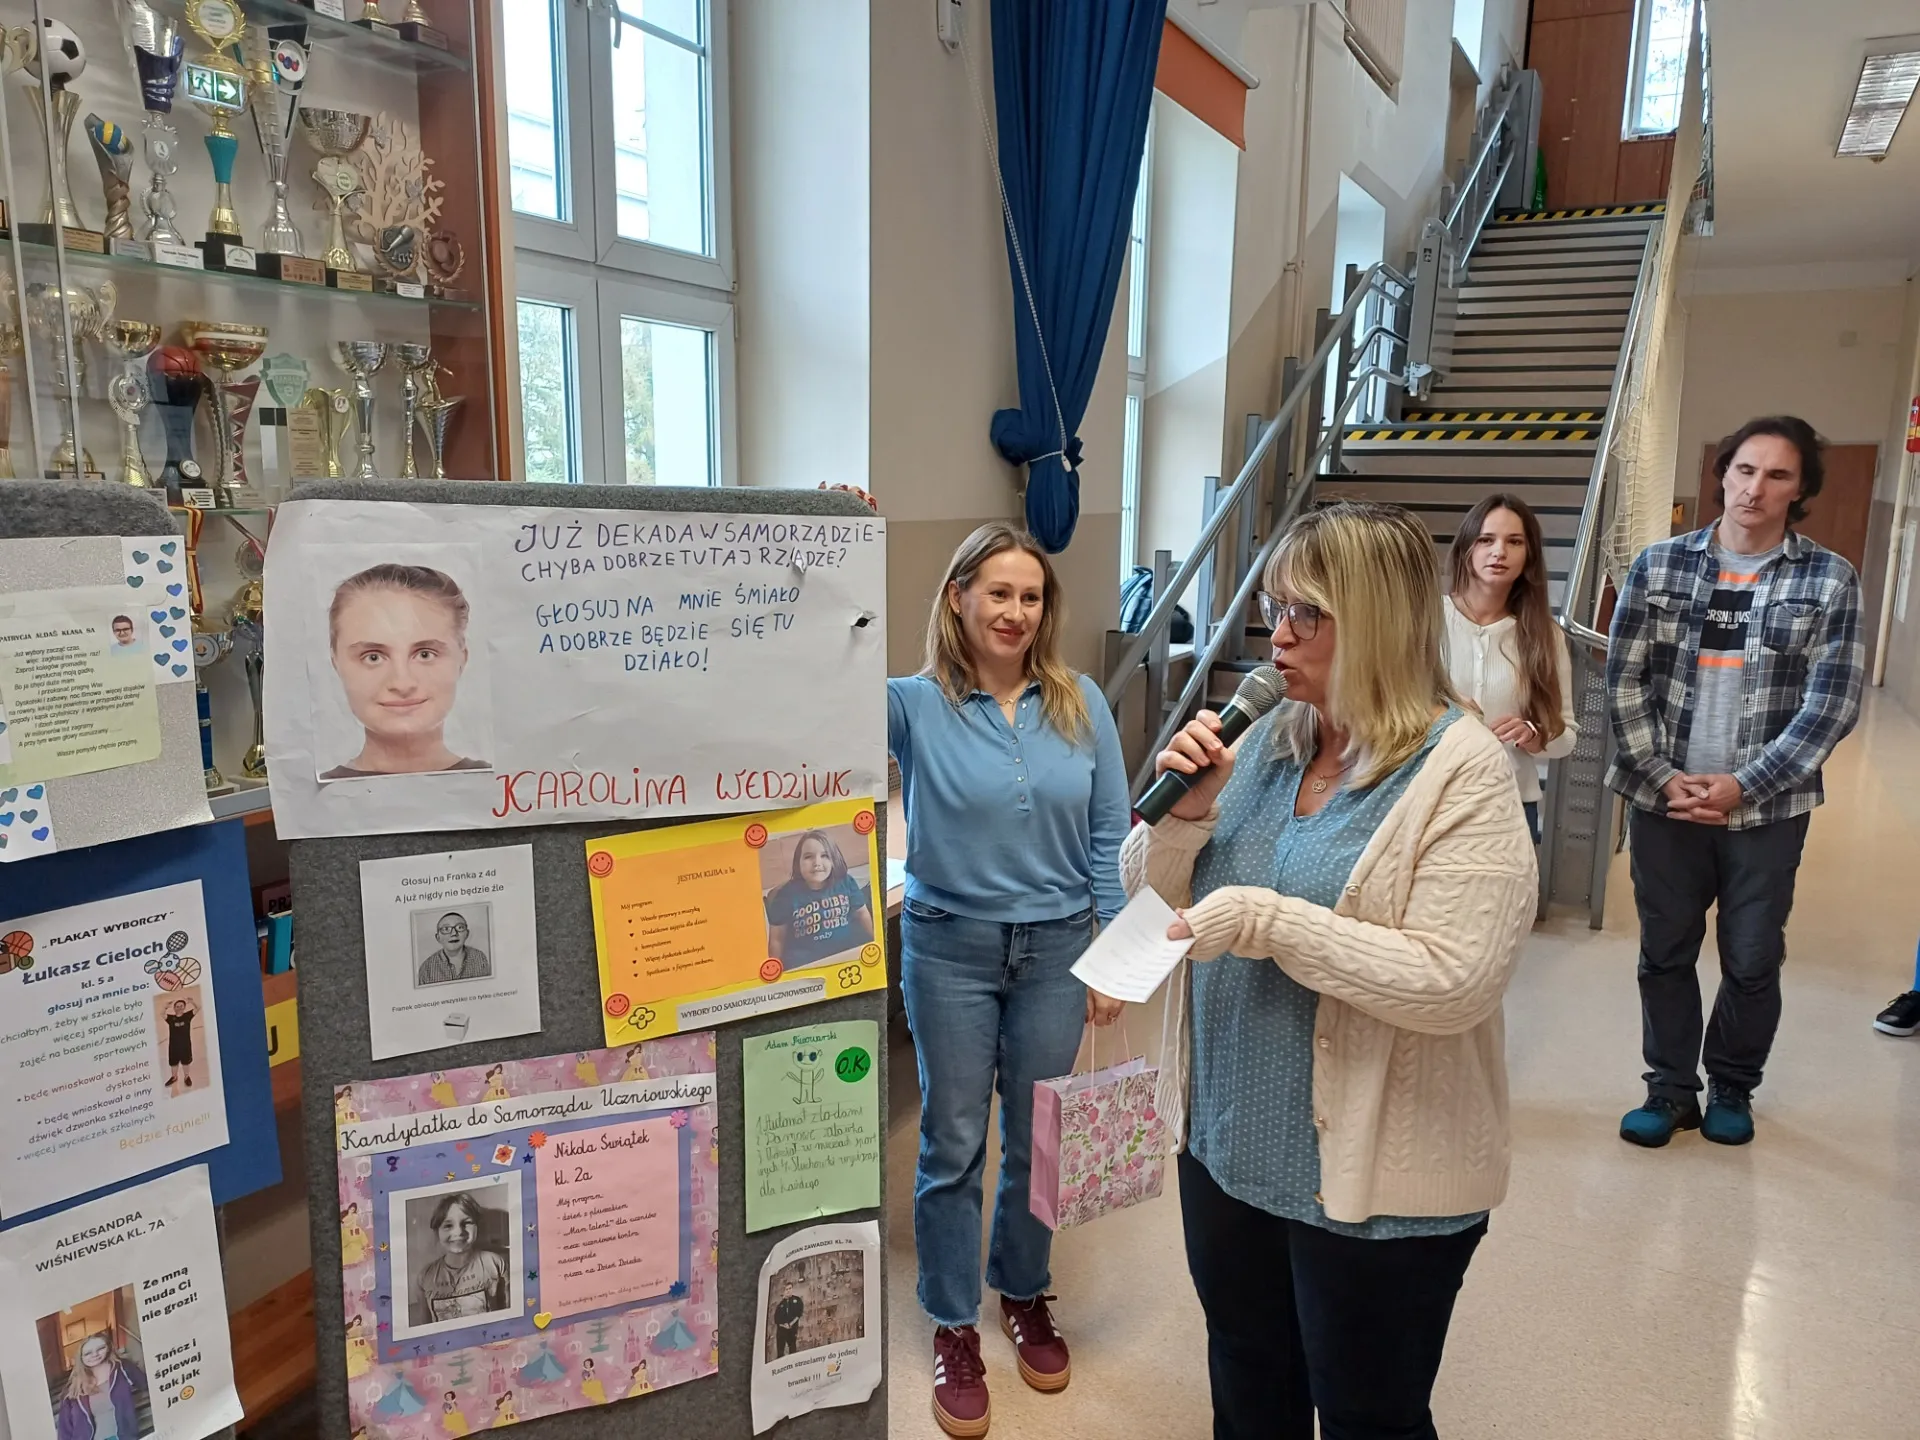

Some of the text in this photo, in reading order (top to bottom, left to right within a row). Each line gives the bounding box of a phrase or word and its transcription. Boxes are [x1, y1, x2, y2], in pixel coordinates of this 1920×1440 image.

[514, 520, 583, 553] JUŻ
[521, 558, 596, 582] CHYBA
[603, 551, 675, 571] DOBRZE
[680, 548, 751, 566] TUTAJ
[536, 582, 800, 627] GŁOSUJ NA MNIE ŚMIAŁO
[539, 613, 794, 653] A DOBRZE BĘDZIE SIĘ TU
[625, 648, 708, 671] DZIAŁO!
[492, 767, 688, 818] KAROLINA
[401, 876, 431, 887] Głosuj
[446, 871, 477, 881] Franka
[485, 869, 497, 877] 4d
[677, 872, 703, 885] JESTEM
[704, 868, 723, 878] KUBA
[395, 884, 504, 904] A już nigdy nie będzie źle
[793, 901, 820, 919] GOOD
[813, 931, 832, 941] only
[21, 941, 164, 985] Łukasz Cieloch
[81, 978, 95, 990] kl.
[98, 977, 104, 985] 5
[47, 983, 150, 1015] głosuj na mnie bo:
[392, 1004, 412, 1012] Franek
[413, 1001, 440, 1010] obiecuje
[681, 984, 823, 1019] WYBORY DO SAMORZĄDU UCZNIOWSKIEGO
[0, 1025, 52, 1044] chciałbym,
[55, 1017, 79, 1029] żeby
[91, 1005, 121, 1019] szkole
[124, 1000, 143, 1012] było
[53, 1031, 85, 1044] więcej
[764, 1040, 788, 1051] Adam
[20, 1053, 47, 1069] zajęć
[49, 1051, 61, 1059] na
[93, 1040, 148, 1062] sportowych
[836, 1055, 869, 1075] O.K.
[24, 1089, 49, 1102] będę
[51, 1073, 105, 1093] wnioskował
[114, 1060, 150, 1075] szkolne
[105, 1074, 151, 1093] dyskoteki
[44, 1087, 153, 1125] będę wnioskował o inny
[341, 1081, 713, 1153] Kandydatka do Samorządu Uczniowskiego
[28, 1100, 154, 1145] dźwięk dzwonka szkolnego
[23, 1113, 156, 1161] więcej wycieczek szkolnych
[119, 1131, 163, 1150] Będzie
[554, 1129, 650, 1159] Nikola Świątek
[554, 1167, 593, 1186] kl. 2a
[55, 1211, 143, 1250] ALEKSANDRA
[615, 1217, 628, 1225] dla
[36, 1219, 165, 1274] WIŚNIEWSKA KL. 7A
[804, 1240, 833, 1251] ZAWADZKI
[142, 1266, 189, 1291] Ze mną
[144, 1279, 192, 1306] nuda Ci
[141, 1292, 199, 1323] nie grozi!
[154, 1338, 197, 1363] Tańcz i
[771, 1364, 793, 1377] Razem
[794, 1355, 827, 1368] strzelamy
[838, 1347, 858, 1359] jednej
[154, 1352, 202, 1380] śpiewaj
[159, 1367, 201, 1393] tak jak
[787, 1376, 811, 1388] bramki
[167, 1394, 179, 1408] ja
